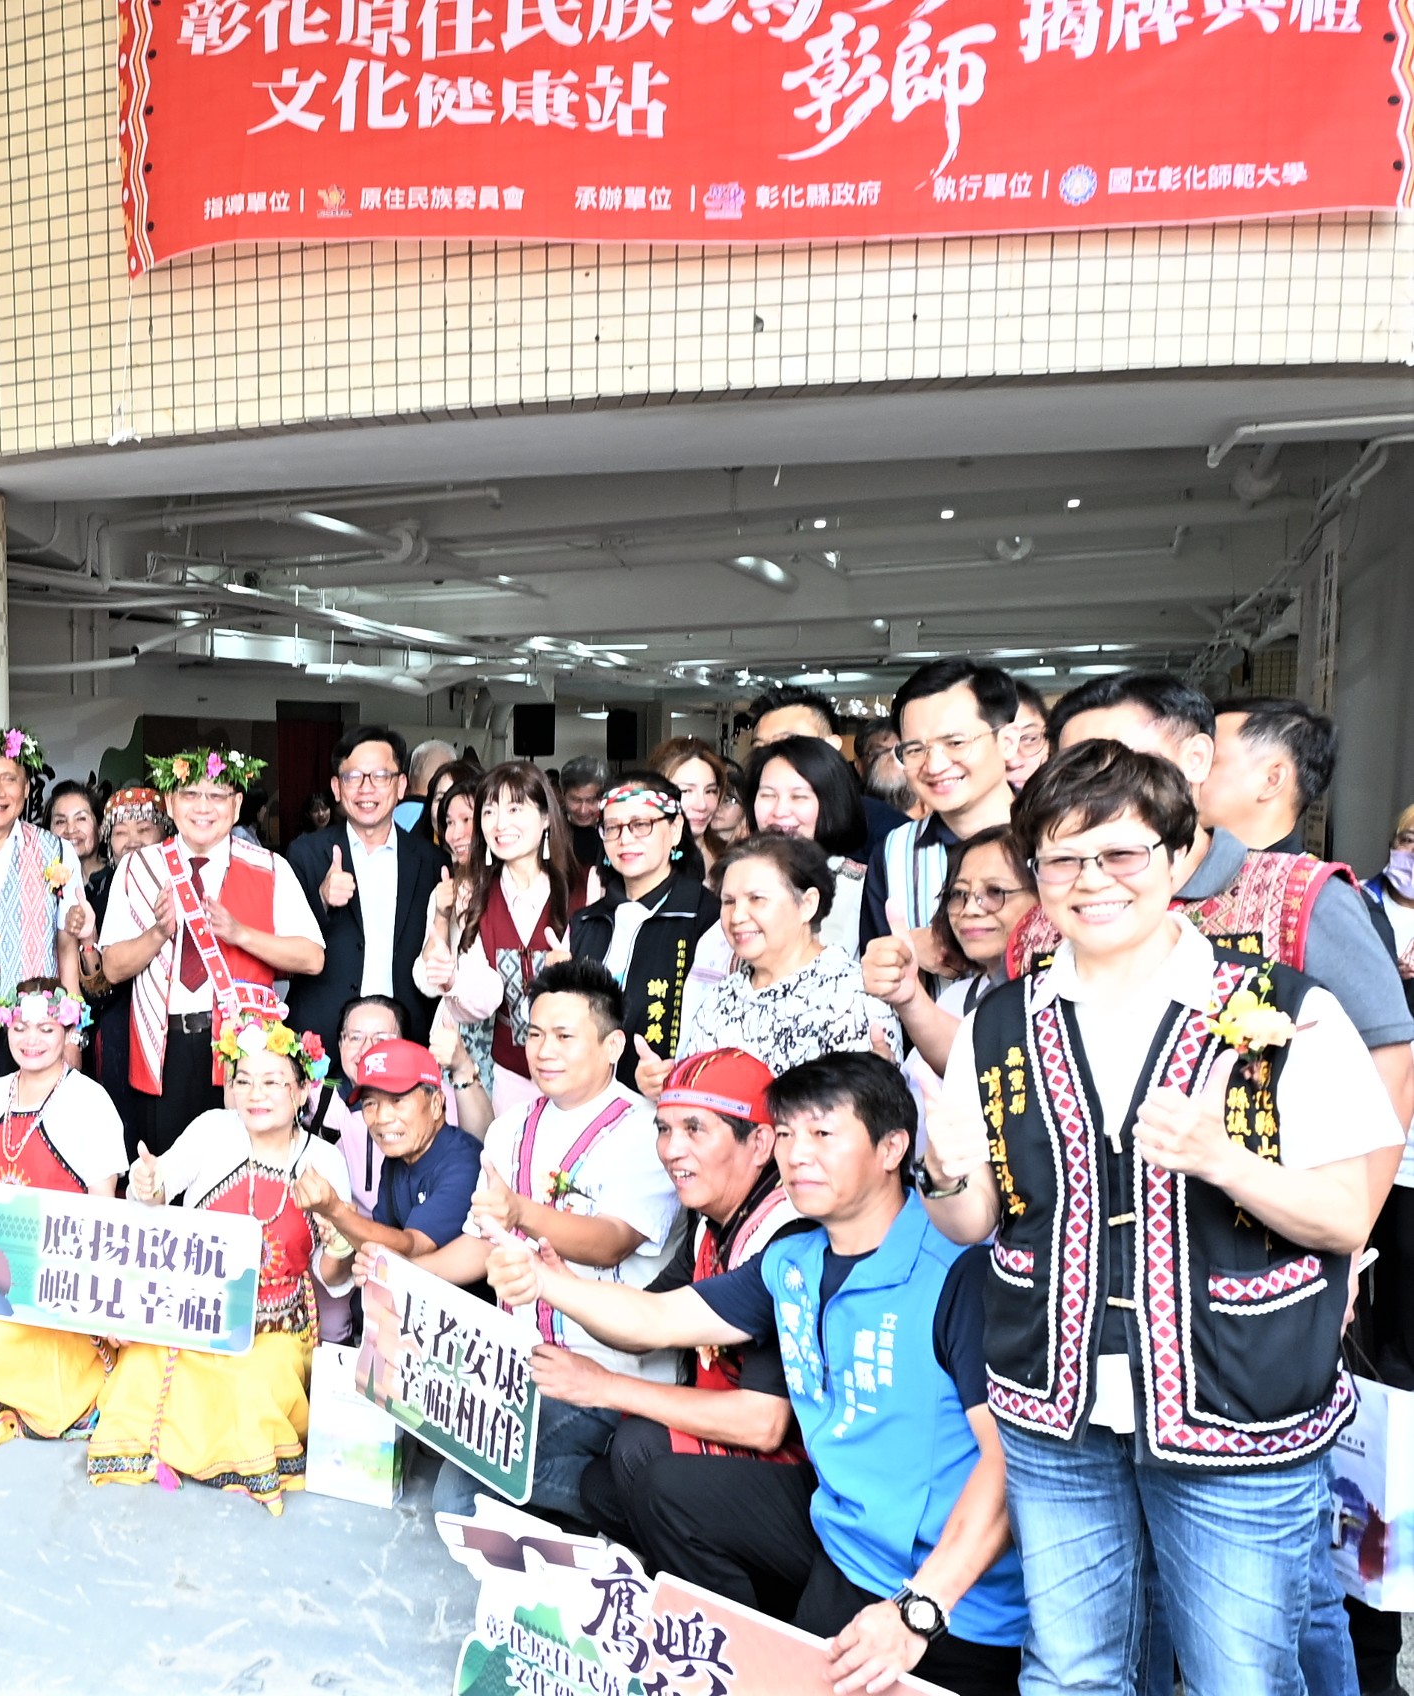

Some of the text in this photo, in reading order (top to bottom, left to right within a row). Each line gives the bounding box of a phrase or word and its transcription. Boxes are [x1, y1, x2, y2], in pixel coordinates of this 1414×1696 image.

[246, 58, 670, 139] 文化健康站
[778, 14, 997, 190] 彰師
[203, 190, 291, 219] 指導單位
[359, 186, 525, 211] 原住民族委員會
[575, 186, 672, 211] 承辦單位
[755, 182, 882, 209] 彰化縣政府
[932, 176, 1032, 203] 執行單位
[1107, 161, 1308, 195] 國立彰化師範大學
[42, 1214, 228, 1279] 鷹揚啟航
[39, 1268, 222, 1334] 嶼見幸福
[400, 1291, 528, 1405] 長者安康
[400, 1352, 520, 1468] 幸福相伴
[581, 1557, 733, 1675] 鷹嶼
